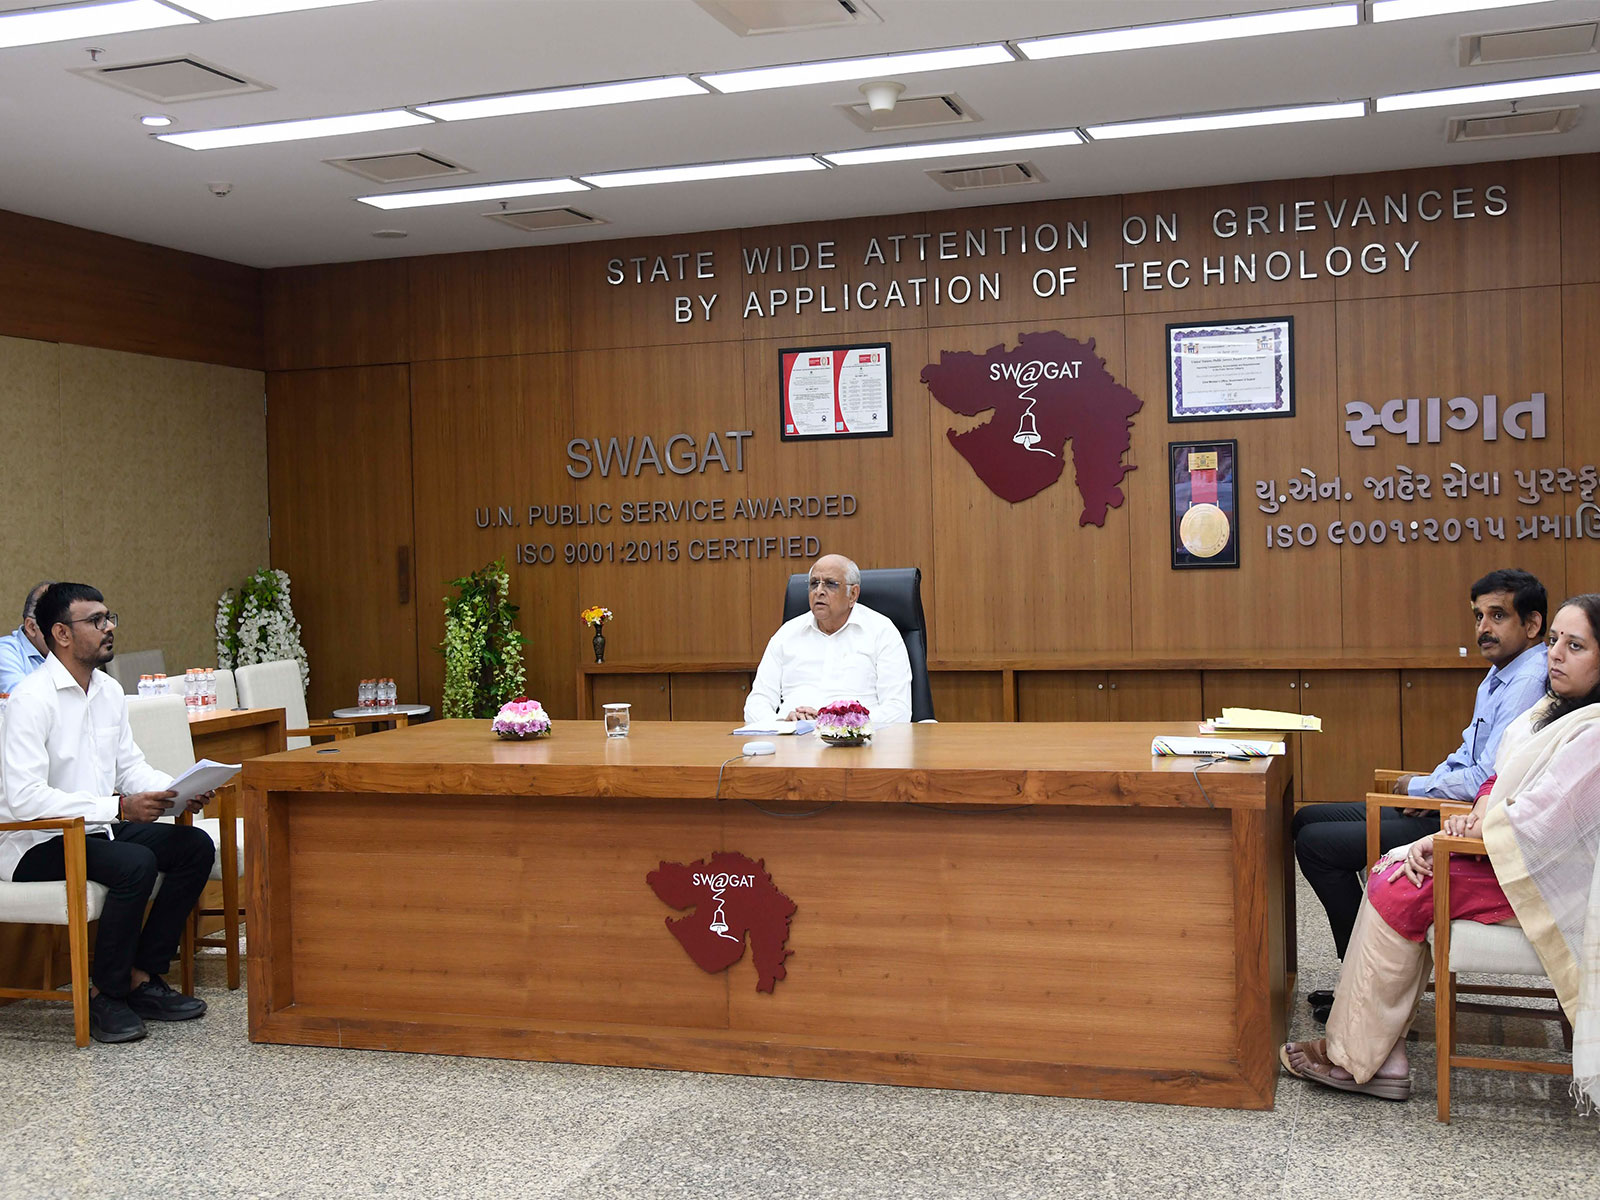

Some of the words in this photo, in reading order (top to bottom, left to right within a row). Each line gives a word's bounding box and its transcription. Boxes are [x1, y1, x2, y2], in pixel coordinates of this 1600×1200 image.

[606, 251, 715, 286] STATE
[743, 241, 836, 275] WIDE
[864, 220, 1088, 266] ATTENTION
[1122, 212, 1178, 246] ON
[1212, 185, 1508, 239] GRIEVANCES
[675, 294, 719, 323] BY
[743, 272, 1001, 318] APPLICATION
[1032, 266, 1078, 298] OF
[1115, 240, 1421, 292] TECHNOLOGY
[989, 360, 1083, 388] SW@GAT
[1345, 392, 1546, 447] સ્વાગત
[566, 430, 753, 480] SWAGAT
[1363, 464, 1432, 501] જાહેર
[1442, 462, 1500, 498] સેવા
[1514, 464, 1600, 505] પુરસ્કૃ
[475, 505, 521, 528] U.N.
[528, 502, 613, 526] PUBLIC
[620, 499, 725, 523] SERVICE
[733, 494, 858, 520] AWARDED
[516, 542, 556, 565] ISO
[564, 539, 680, 564] 9001:2015
[688, 535, 822, 561] CERTIFIED
[1266, 521, 1318, 549] ISO
[692, 872, 756, 892] SW@GAT
